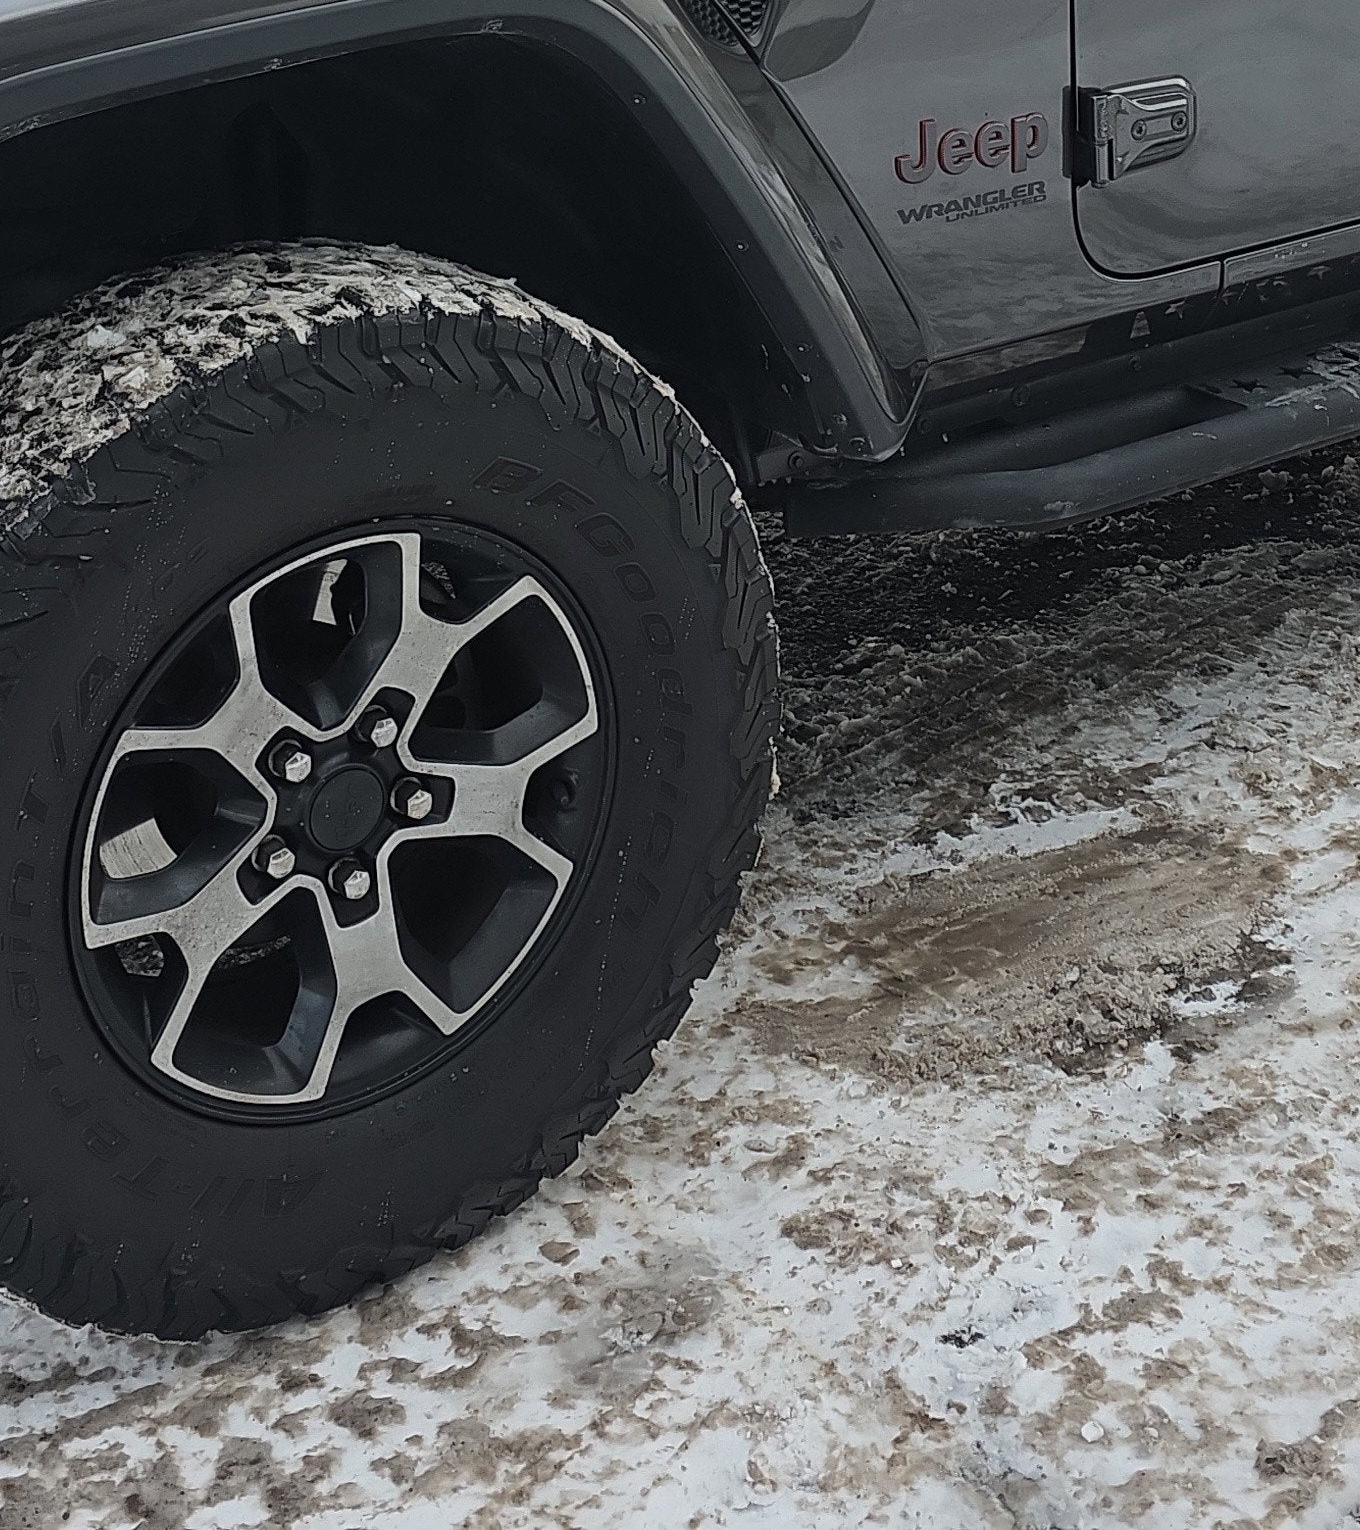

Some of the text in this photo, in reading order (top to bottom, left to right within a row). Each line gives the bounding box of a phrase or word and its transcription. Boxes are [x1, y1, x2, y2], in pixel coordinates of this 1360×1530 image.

[894, 112, 1049, 184] Jeep
[896, 180, 1047, 224] WRANGLER
[945, 194, 1047, 222] UNLIMITED
[473, 454, 693, 930] BFGoodrich
